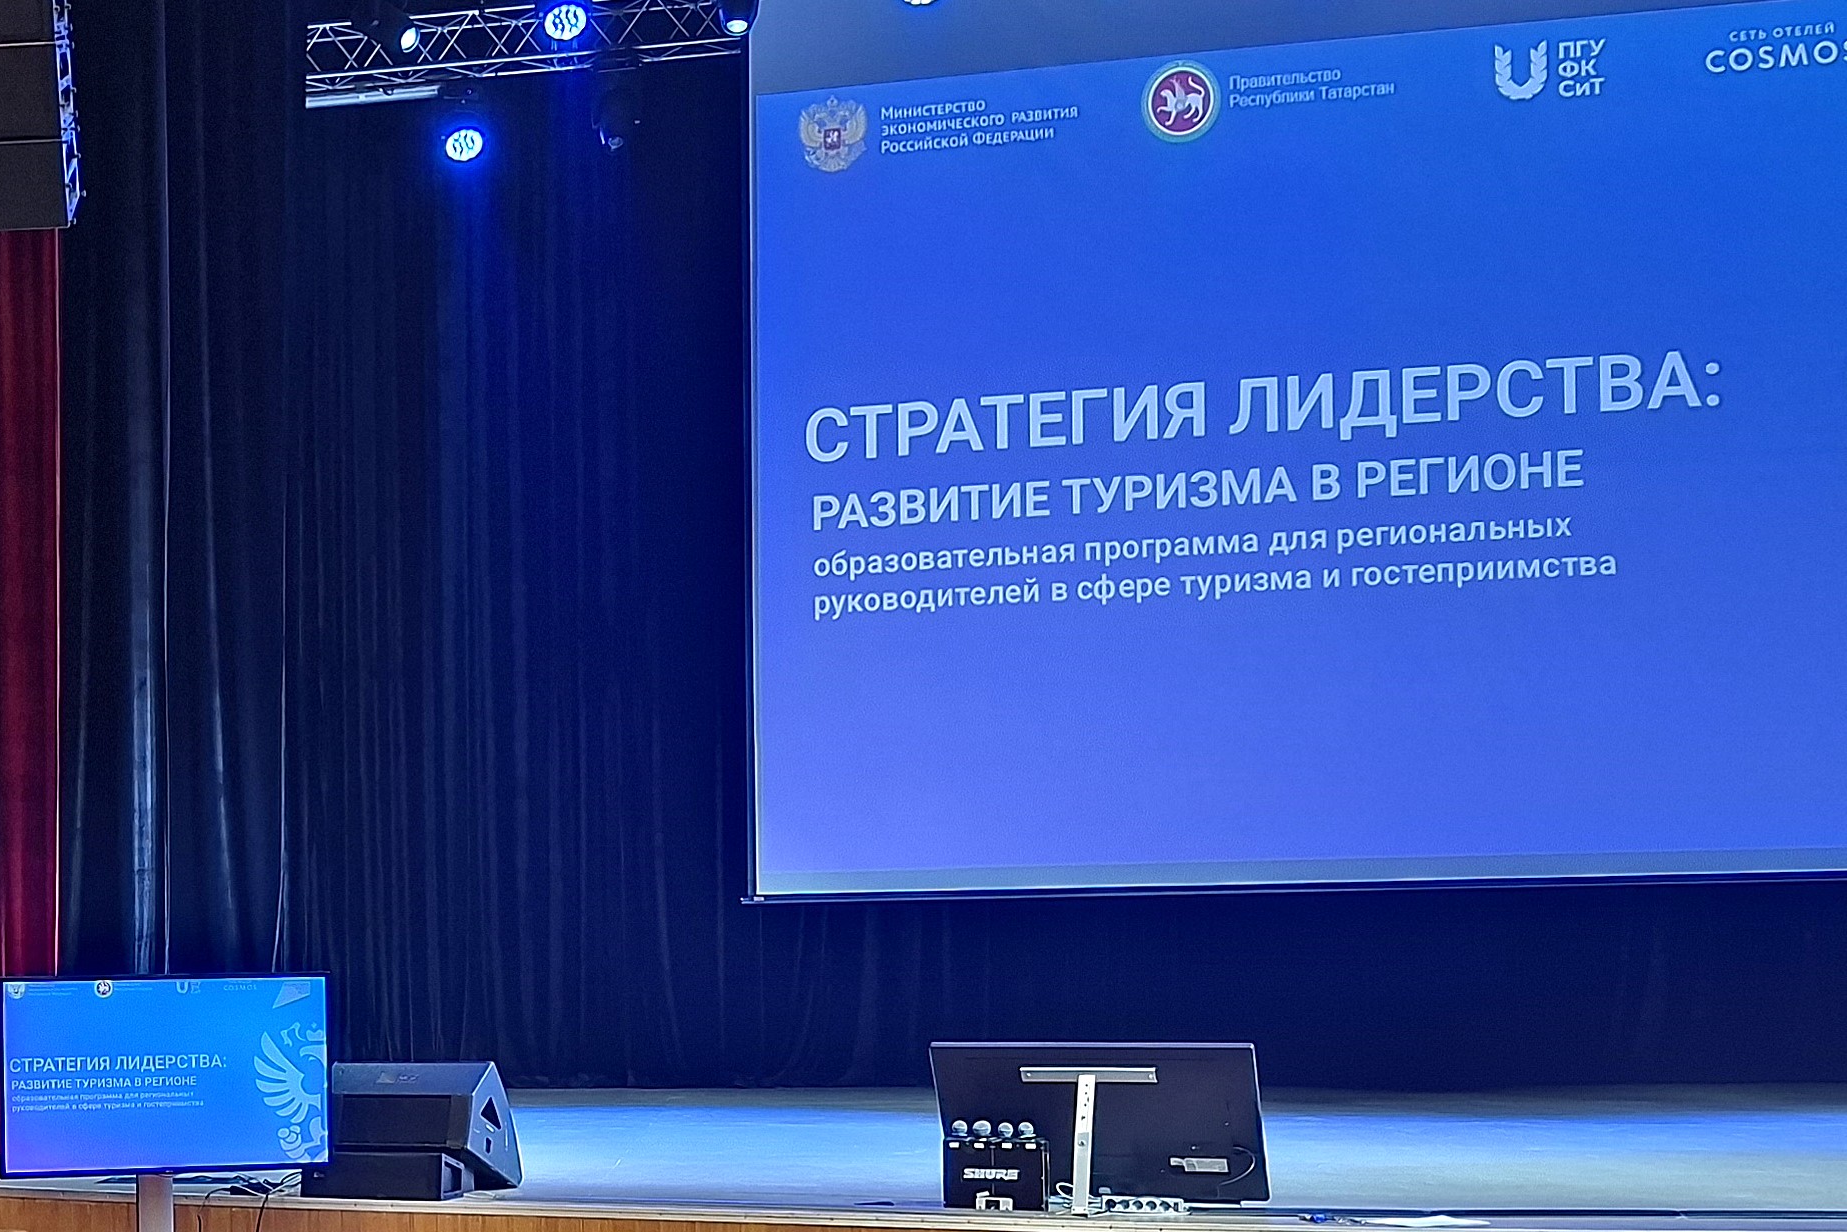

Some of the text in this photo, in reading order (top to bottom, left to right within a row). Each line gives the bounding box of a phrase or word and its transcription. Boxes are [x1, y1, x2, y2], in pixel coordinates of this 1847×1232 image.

[1729, 21, 1835, 43] СЕТЬ ОТЕЛЕЙ
[1558, 38, 1606, 60] ПГУ
[1705, 40, 1847, 74] COSMO
[1229, 68, 1342, 92] Правительство
[1558, 59, 1598, 78] ФК
[1229, 82, 1395, 108] Республики Татарстан
[805, 350, 1721, 462] СТРАТЕГИЯ ЛИДЕРСТВА:
[812, 448, 1585, 531] РАЗВИТИЕ ТУРИЗМА В РЕГИОНЕ
[813, 515, 1572, 580] образовательная программа для региональных
[813, 553, 1617, 621] руководителей в сфере туризма и гостеприимства
[9, 1054, 227, 1073] СТРАТЕГИЯ ЛИДЕРСТВА:
[11, 1076, 197, 1090] РАЗВИТИЕ ТУРИЗМА В РЕГИОНЕ
[963, 1168, 1020, 1180] SHURE
